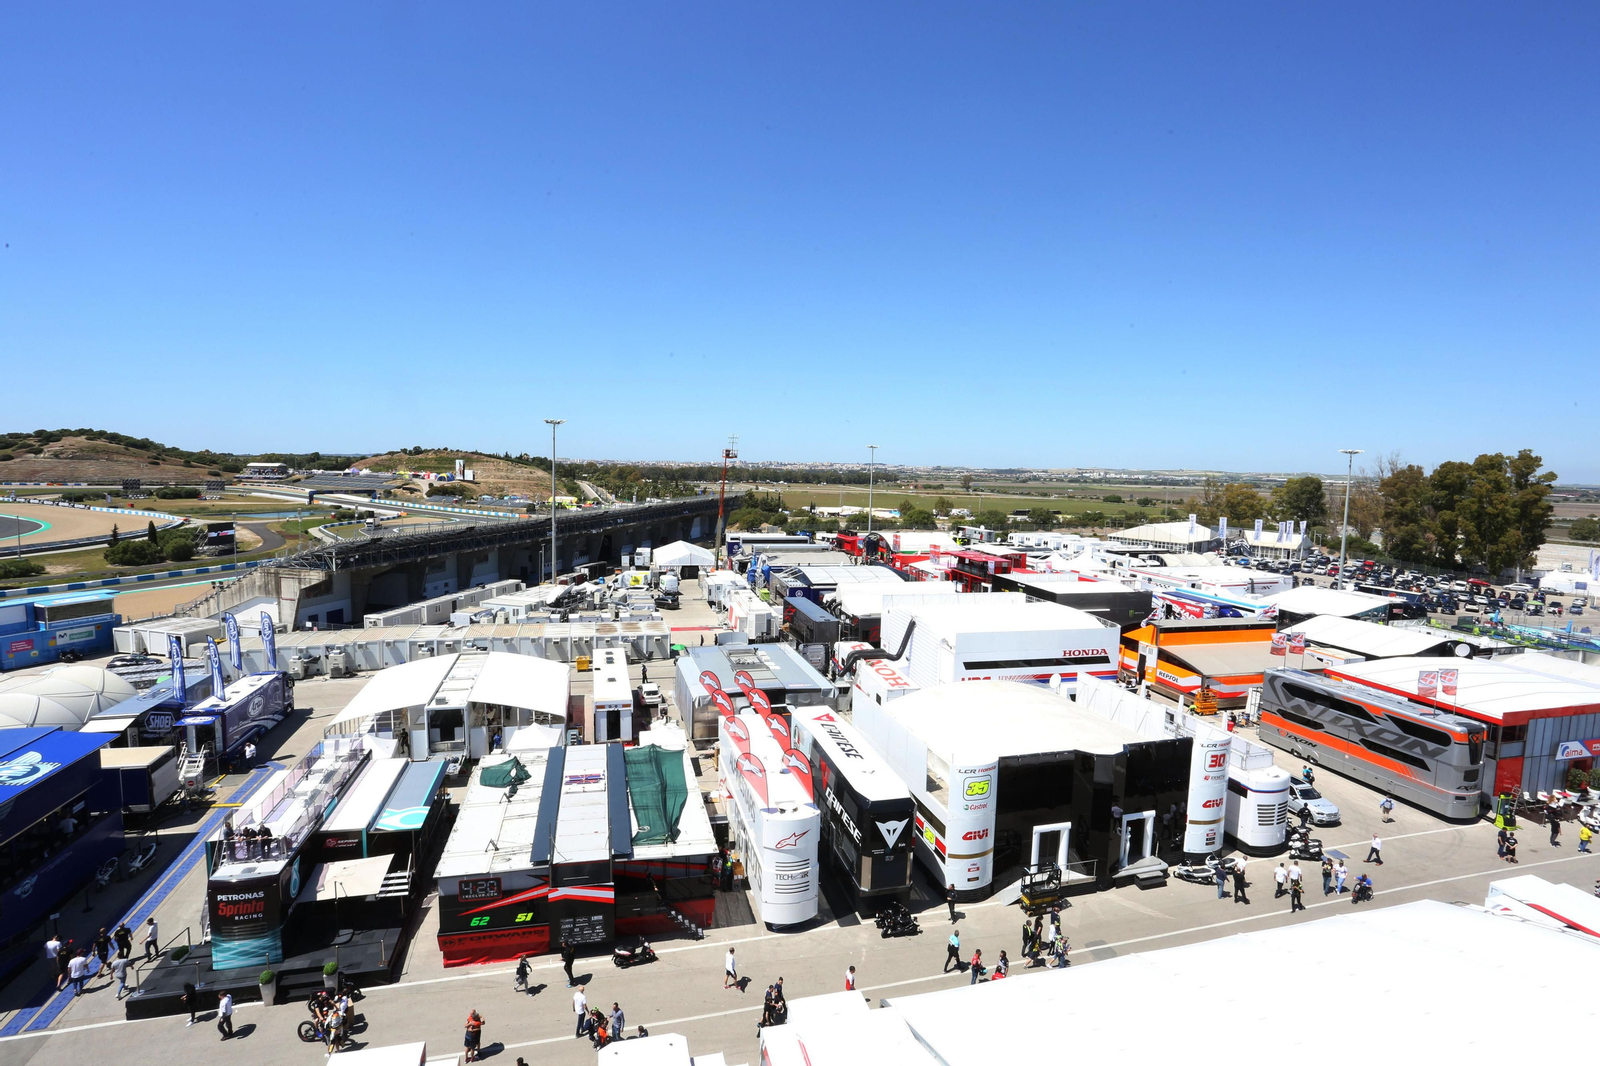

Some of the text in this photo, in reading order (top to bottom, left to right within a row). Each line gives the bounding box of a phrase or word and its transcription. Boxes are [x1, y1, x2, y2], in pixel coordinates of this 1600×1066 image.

[1062, 648, 1108, 656] HONDA
[1159, 671, 1179, 683] REPSOL
[150, 715, 172, 728] SHOEI
[1287, 734, 1318, 747] IXON
[1565, 749, 1583, 757] alma
[1208, 753, 1226, 768] 30
[966, 780, 990, 796] 35
[969, 803, 988, 811] Castrol
[1202, 798, 1224, 808] GIVI
[825, 787, 862, 845] DAINESE
[962, 829, 989, 841] GIVI
[461, 880, 497, 895] 4:20
[217, 891, 264, 901] PETRONAS
[218, 901, 264, 917] Sprinta
[234, 913, 263, 921] RACING
[470, 916, 490, 927] 62
[515, 912, 534, 922] 51
[458, 929, 545, 942] FORWARD
